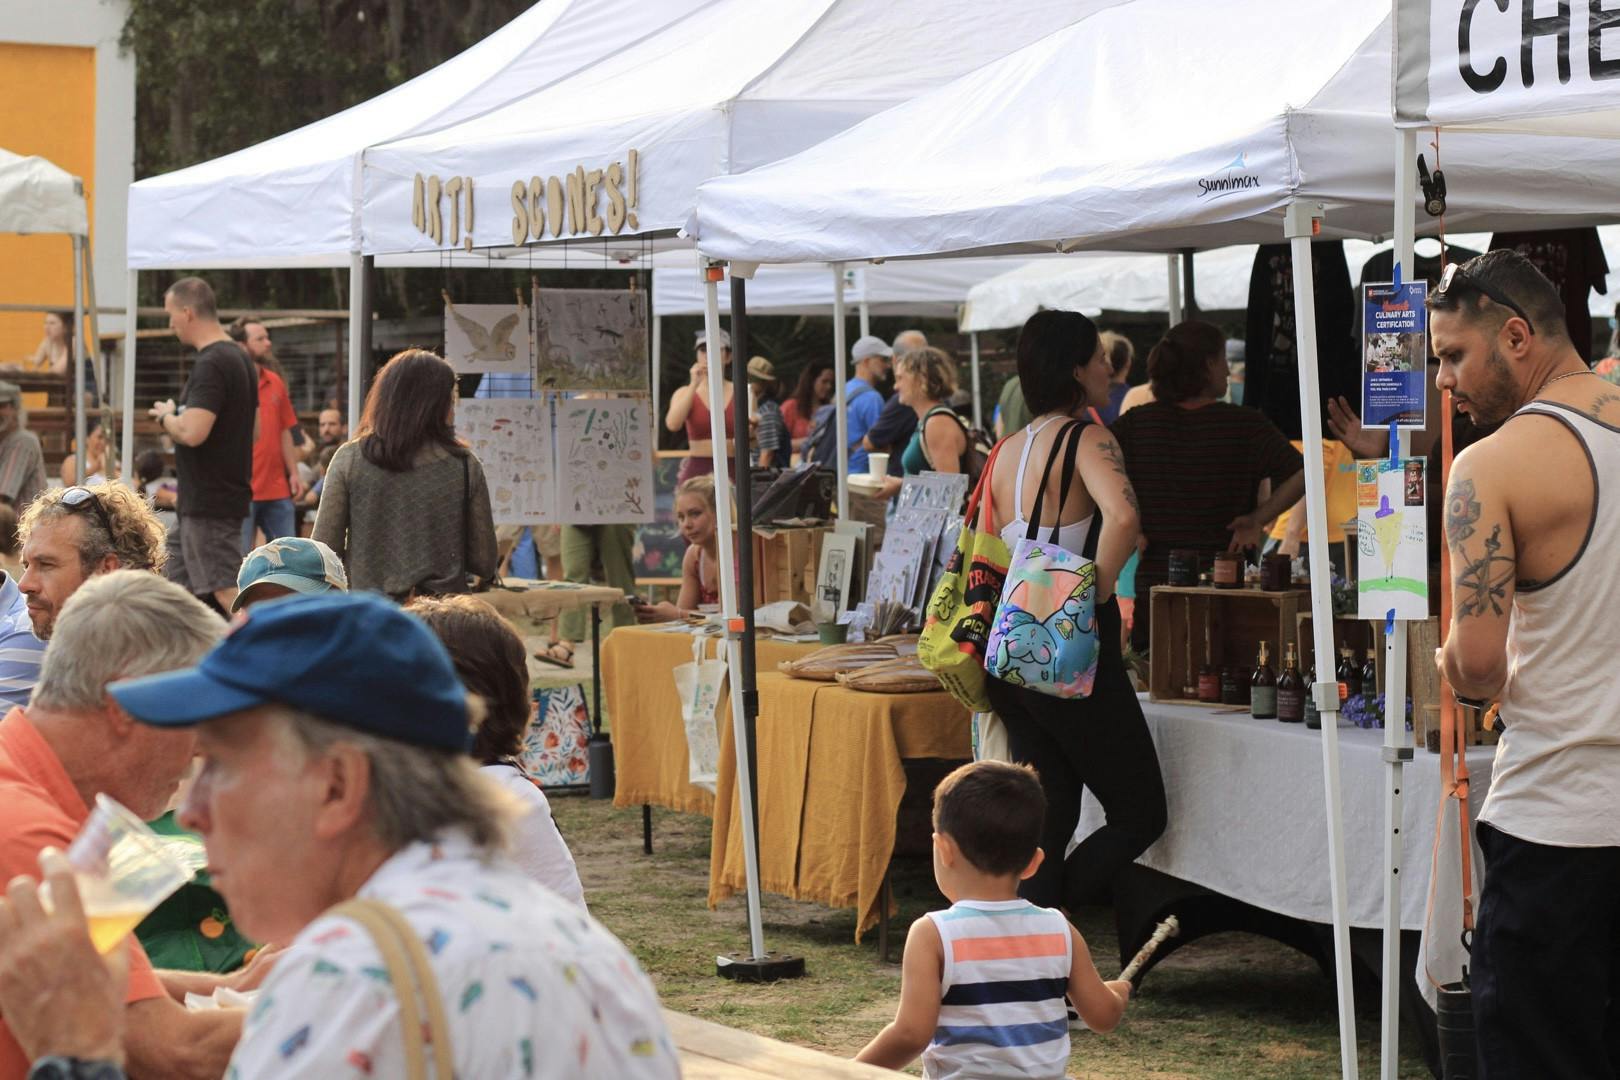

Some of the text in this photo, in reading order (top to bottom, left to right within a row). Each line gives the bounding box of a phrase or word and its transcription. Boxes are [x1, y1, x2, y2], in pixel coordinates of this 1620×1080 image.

[412, 149, 640, 253] ART! SCONES!
[1375, 310, 1416, 319] CULINARY ARTS
[1376, 320, 1415, 329] CERTIFICATION
